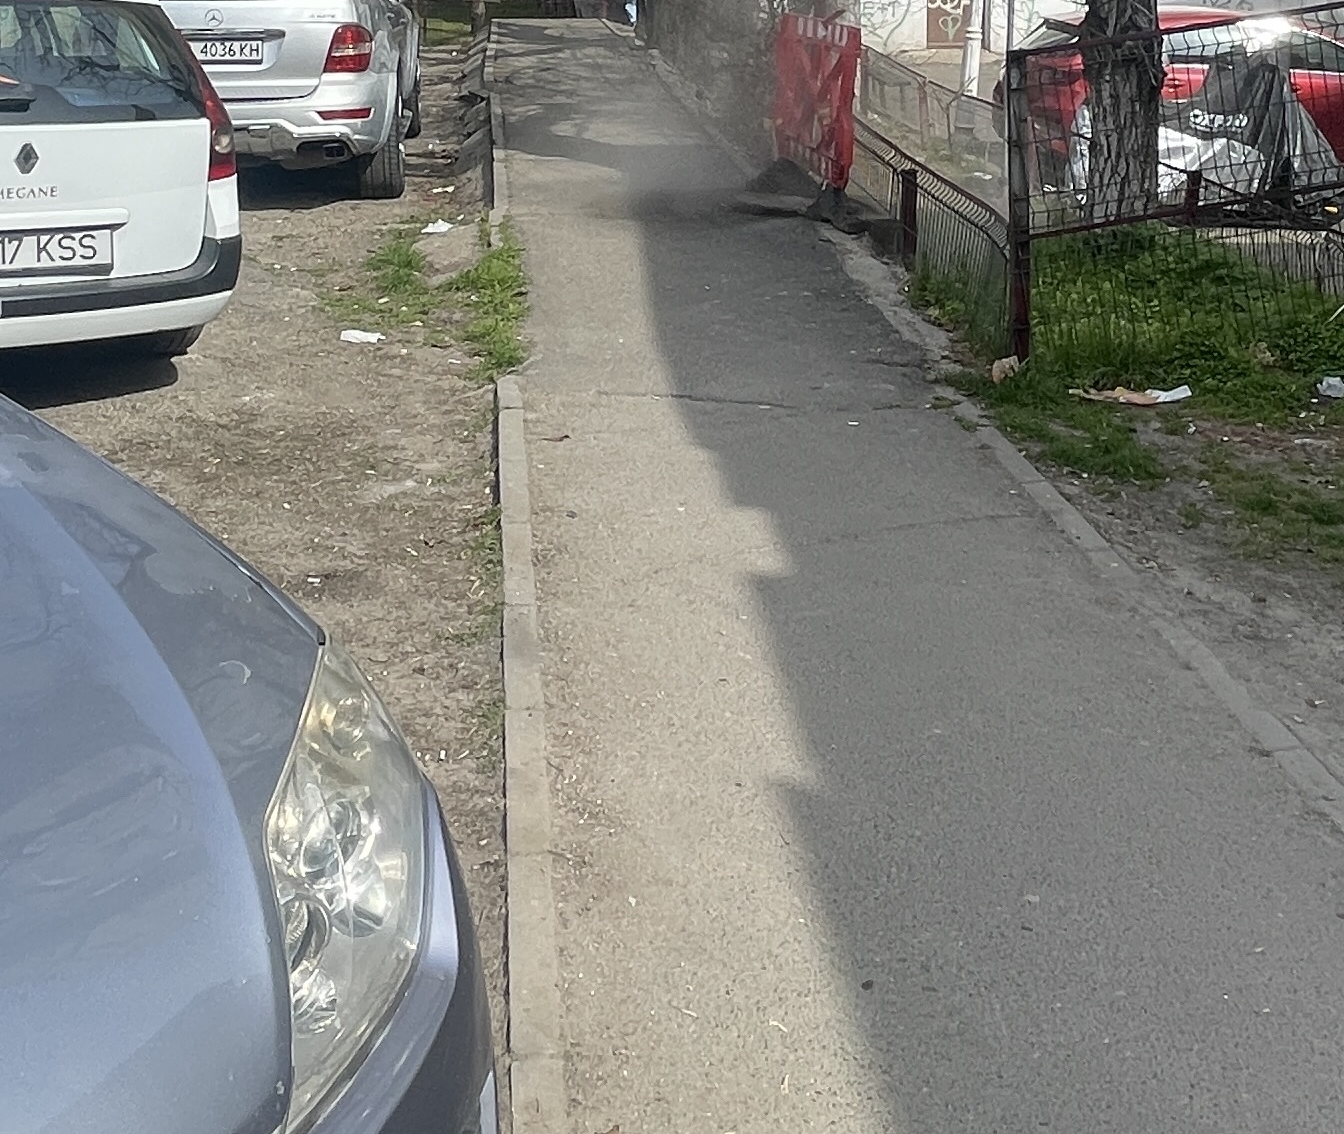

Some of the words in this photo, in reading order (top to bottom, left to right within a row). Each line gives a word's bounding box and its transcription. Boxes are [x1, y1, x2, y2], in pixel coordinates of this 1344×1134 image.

[200, 41, 237, 58] 4036
[239, 42, 260, 58] KH
[36, 233, 97, 263] KSS
